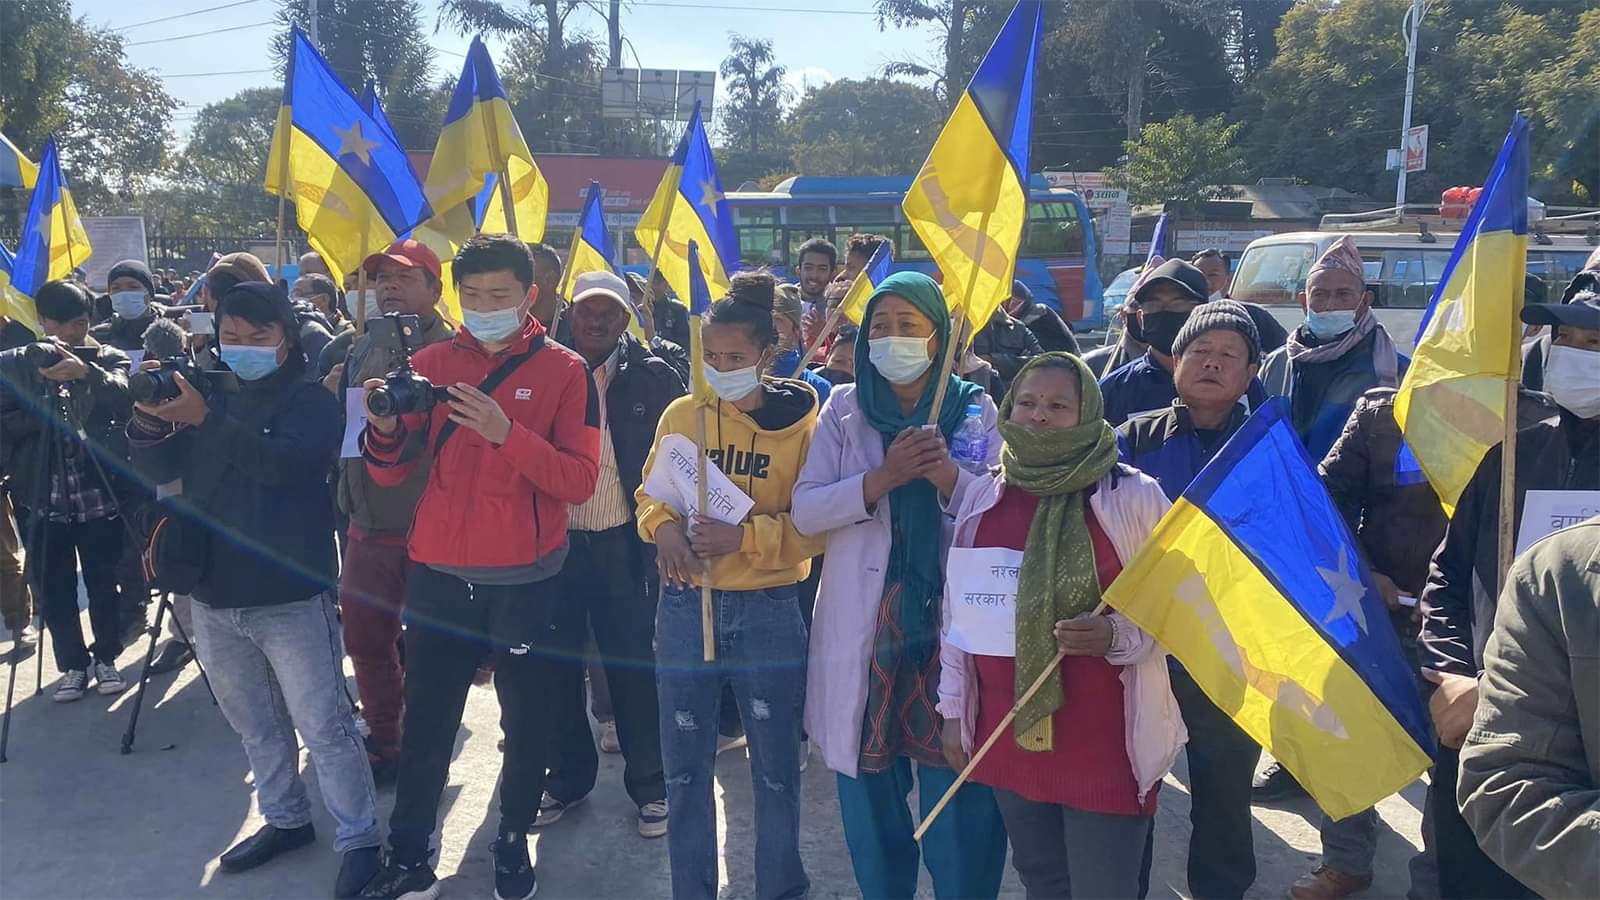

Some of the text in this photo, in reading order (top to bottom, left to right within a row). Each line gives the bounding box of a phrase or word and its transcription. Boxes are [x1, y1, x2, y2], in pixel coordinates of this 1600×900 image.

[705, 444, 770, 479] alue
[990, 566, 1020, 579] नश्ल
[964, 592, 1007, 607] सरकार
